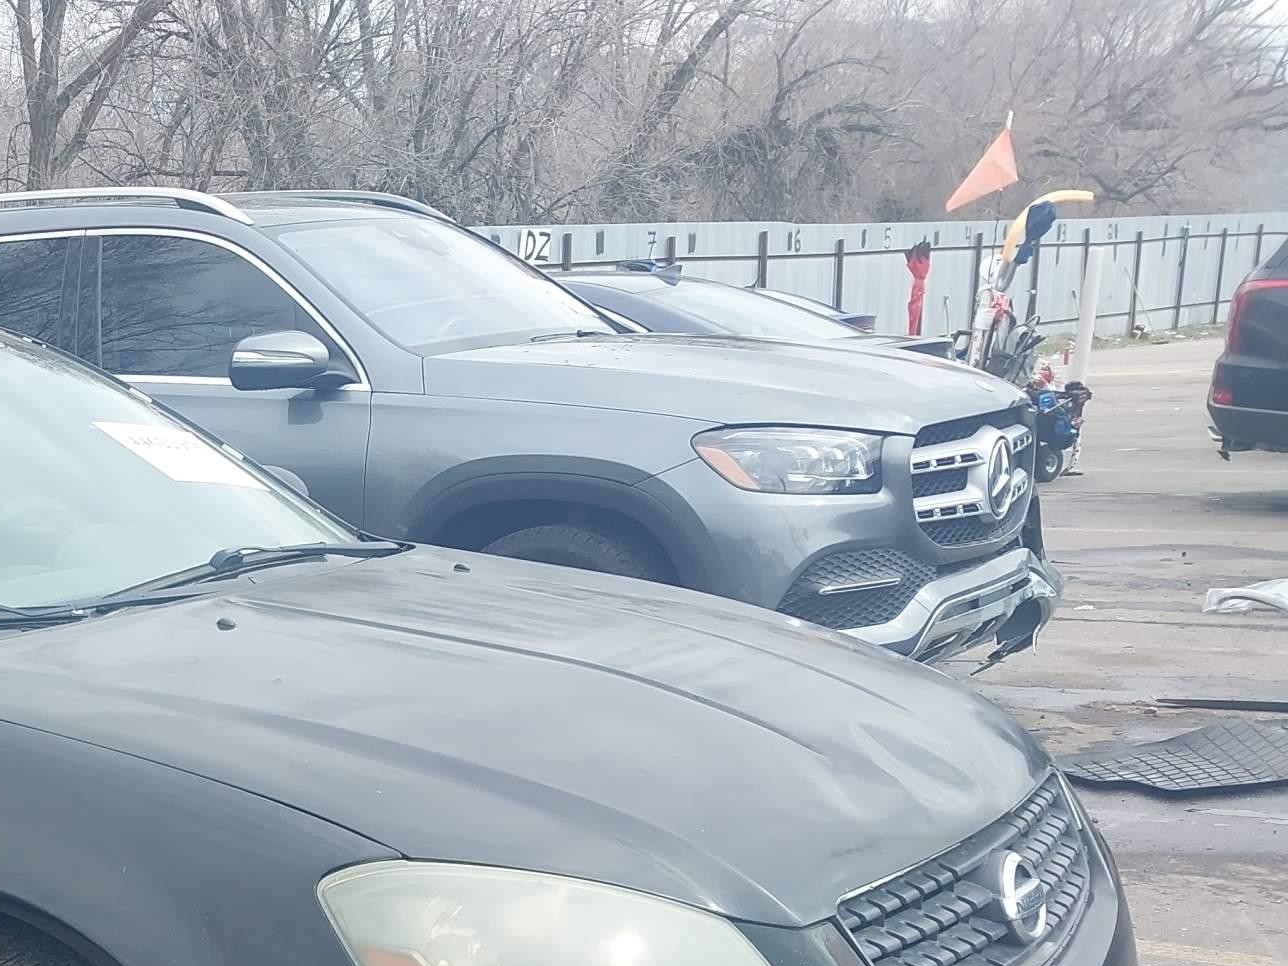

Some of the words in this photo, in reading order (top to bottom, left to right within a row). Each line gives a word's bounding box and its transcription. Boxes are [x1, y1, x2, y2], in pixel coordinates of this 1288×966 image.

[647, 230, 657, 258] 7
[794, 229, 802, 253] 6
[884, 227, 892, 249] 5
